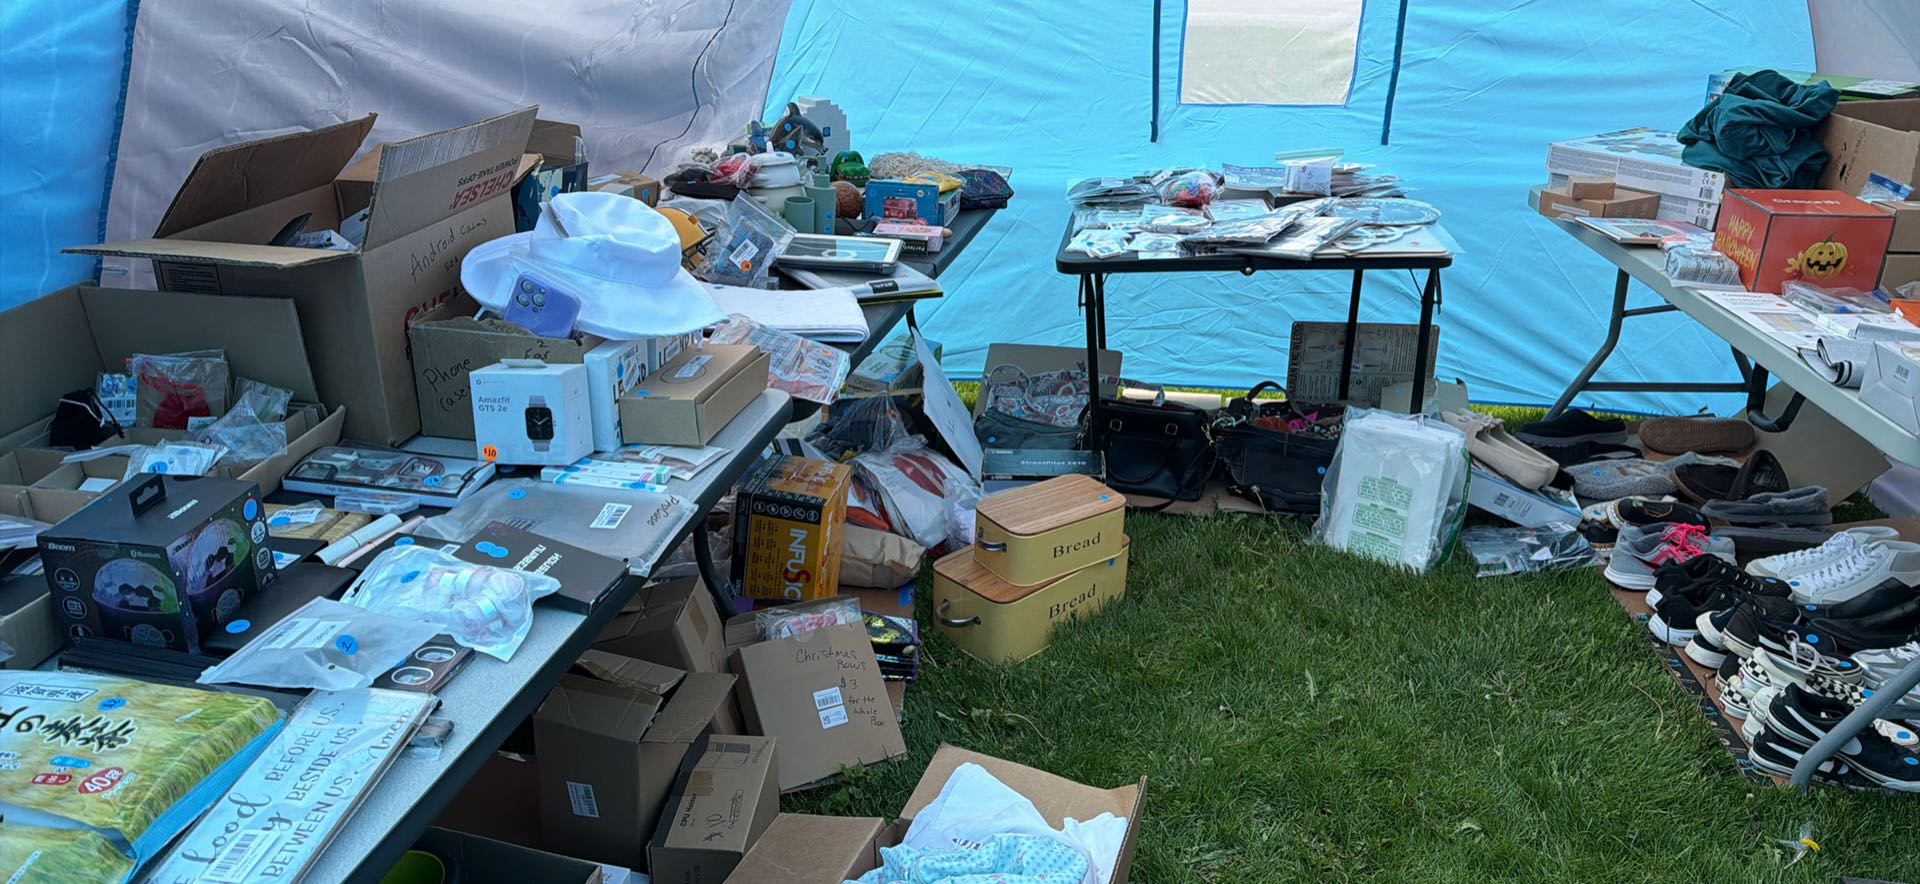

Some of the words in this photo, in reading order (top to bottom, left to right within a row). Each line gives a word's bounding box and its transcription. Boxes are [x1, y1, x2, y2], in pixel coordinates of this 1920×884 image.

[495, 158, 518, 176] POWER
[449, 171, 514, 211] CHELSEA
[1728, 215, 1755, 244] HAPPY
[411, 228, 455, 284] Android
[1716, 232, 1758, 272] HALLOWEEN
[423, 359, 471, 393] Phone
[440, 386, 471, 413] Case
[478, 396, 511, 404] Amazfit
[478, 405, 495, 413] GTS
[497, 405, 508, 413] 2e
[483, 447, 497, 458] $10
[647, 495, 680, 527] ProCase
[1052, 532, 1101, 559] Bread
[535, 553, 562, 576] HOUSE
[1049, 584, 1096, 619] Bread
[796, 646, 858, 663] Christmas
[848, 695, 859, 705] for
[861, 695, 875, 704] the
[870, 716, 885, 727] Box
[265, 729, 320, 782] BEFORE
[286, 748, 337, 802] BESIDE
[680, 813, 691, 827] CPU
[686, 793, 697, 813] Holder
[261, 800, 331, 878] BETWEEN
